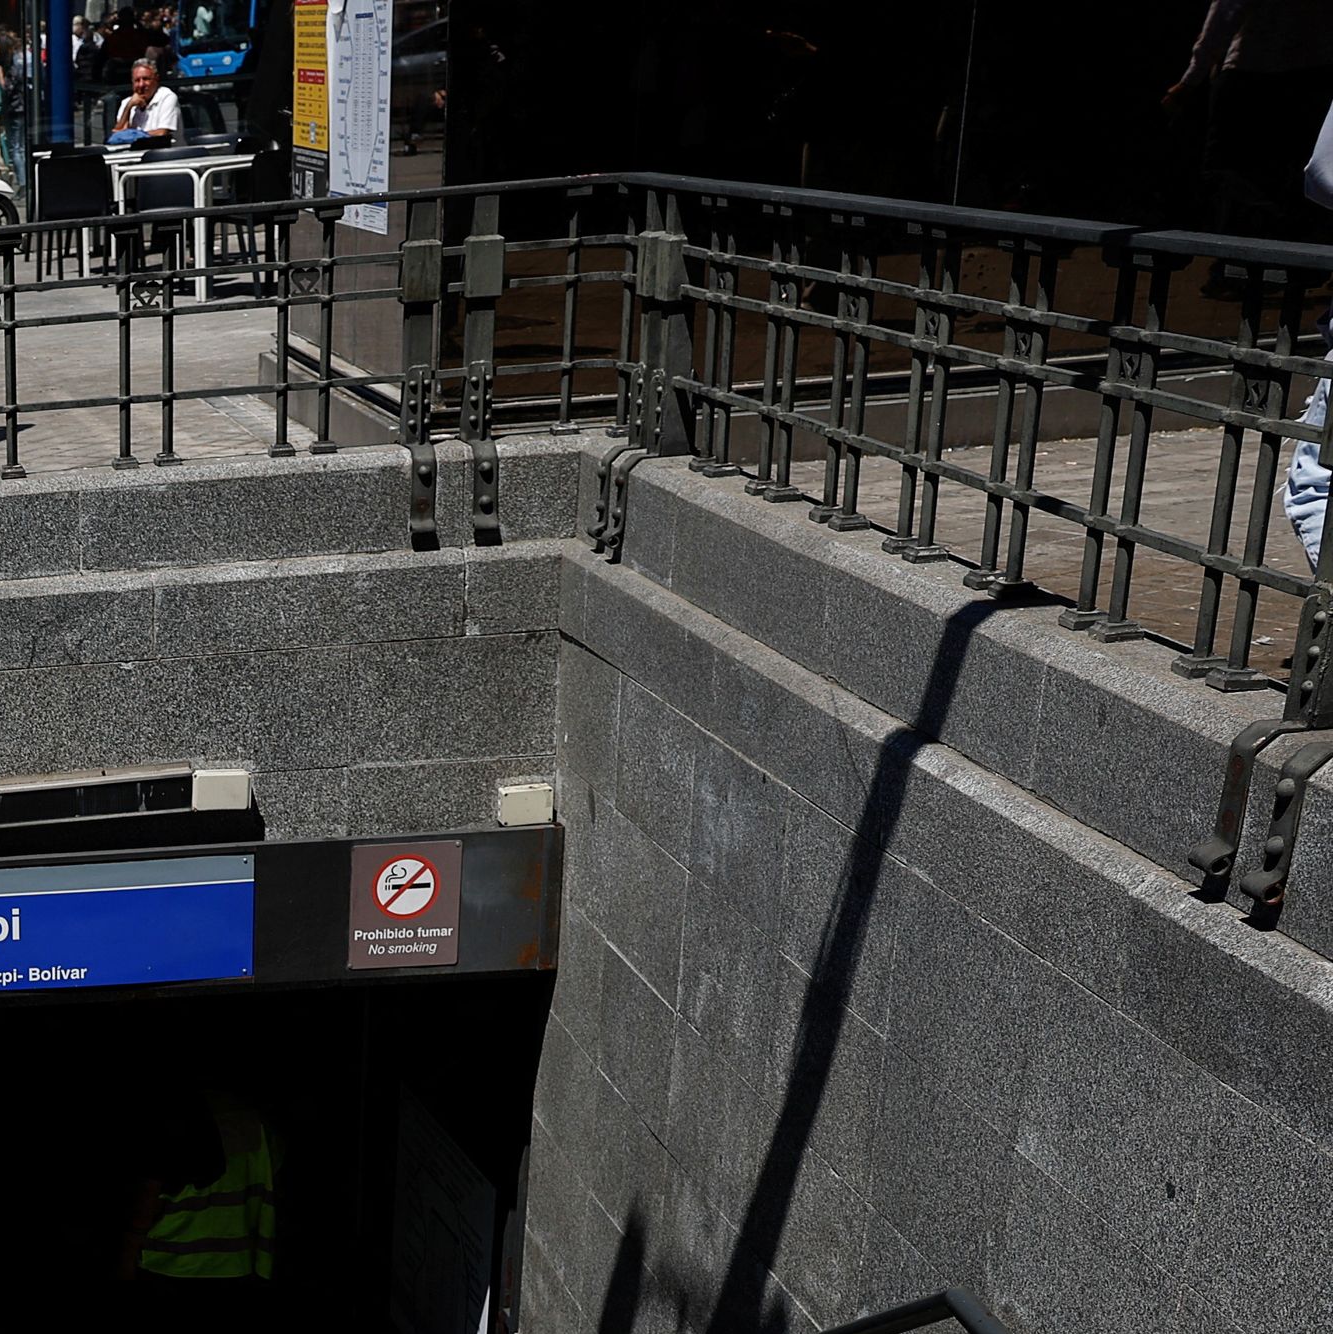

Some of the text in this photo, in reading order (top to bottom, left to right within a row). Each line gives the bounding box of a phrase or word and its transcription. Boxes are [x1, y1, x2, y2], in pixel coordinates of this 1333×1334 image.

[354, 926, 453, 941] Prohibido fumar
[368, 941, 438, 955] No smoking
[29, 965, 87, 982] Bolívar
